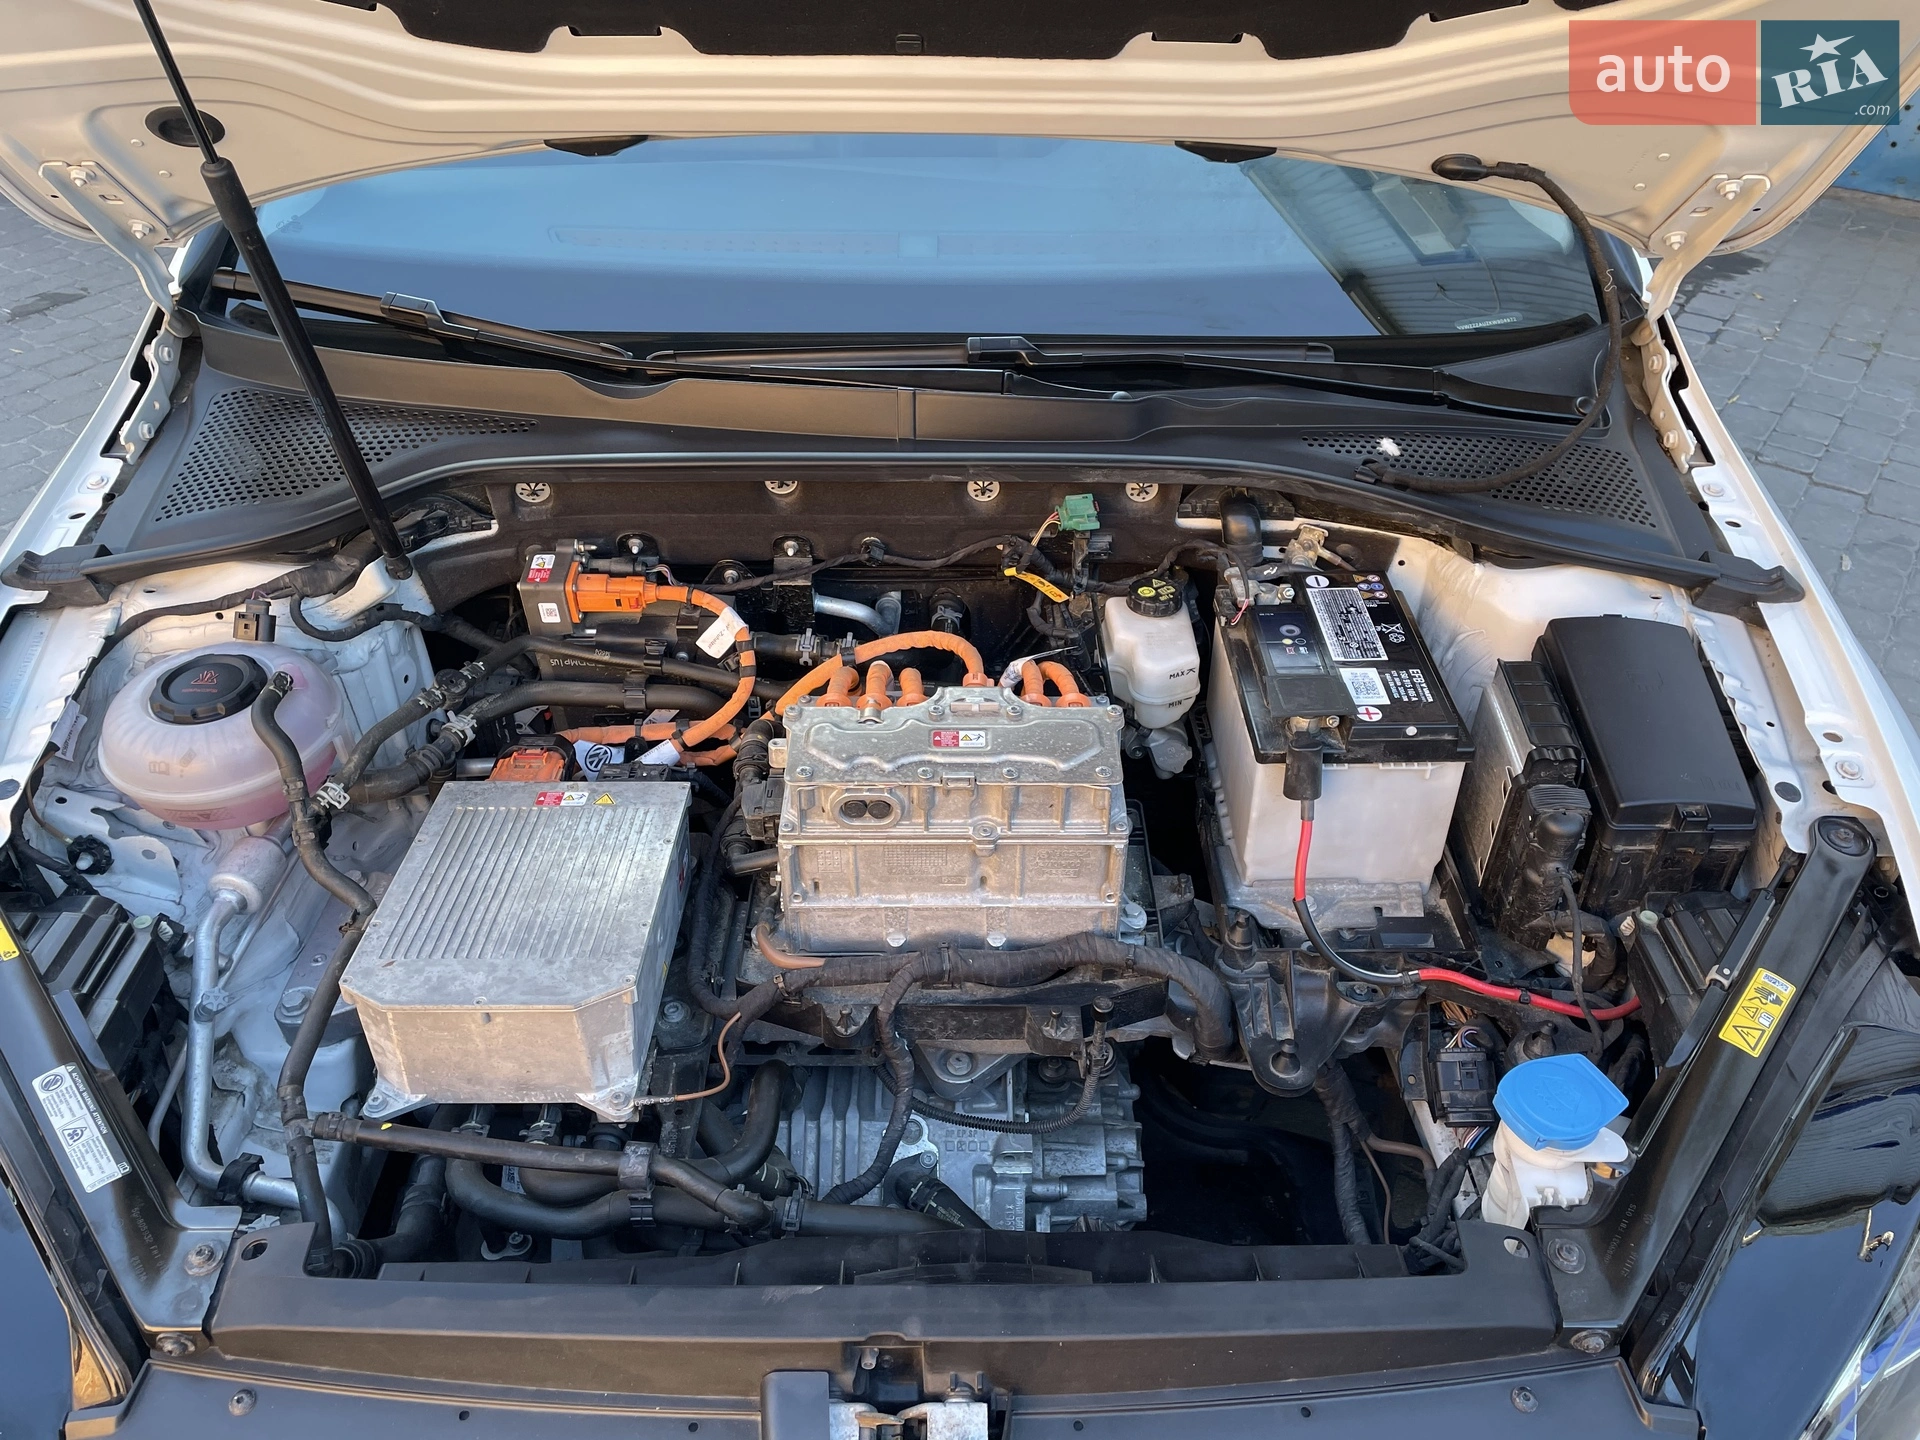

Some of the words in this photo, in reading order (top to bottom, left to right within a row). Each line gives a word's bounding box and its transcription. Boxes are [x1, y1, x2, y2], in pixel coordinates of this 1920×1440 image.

[1169, 670, 1185, 680] MAX
[1409, 669, 1425, 683] EFB
[1168, 699, 1183, 709] MIN
[69, 1070, 86, 1092] ACHTUNG
[80, 1090, 97, 1112] WARNING
[90, 1110, 109, 1135] ATTENTION
